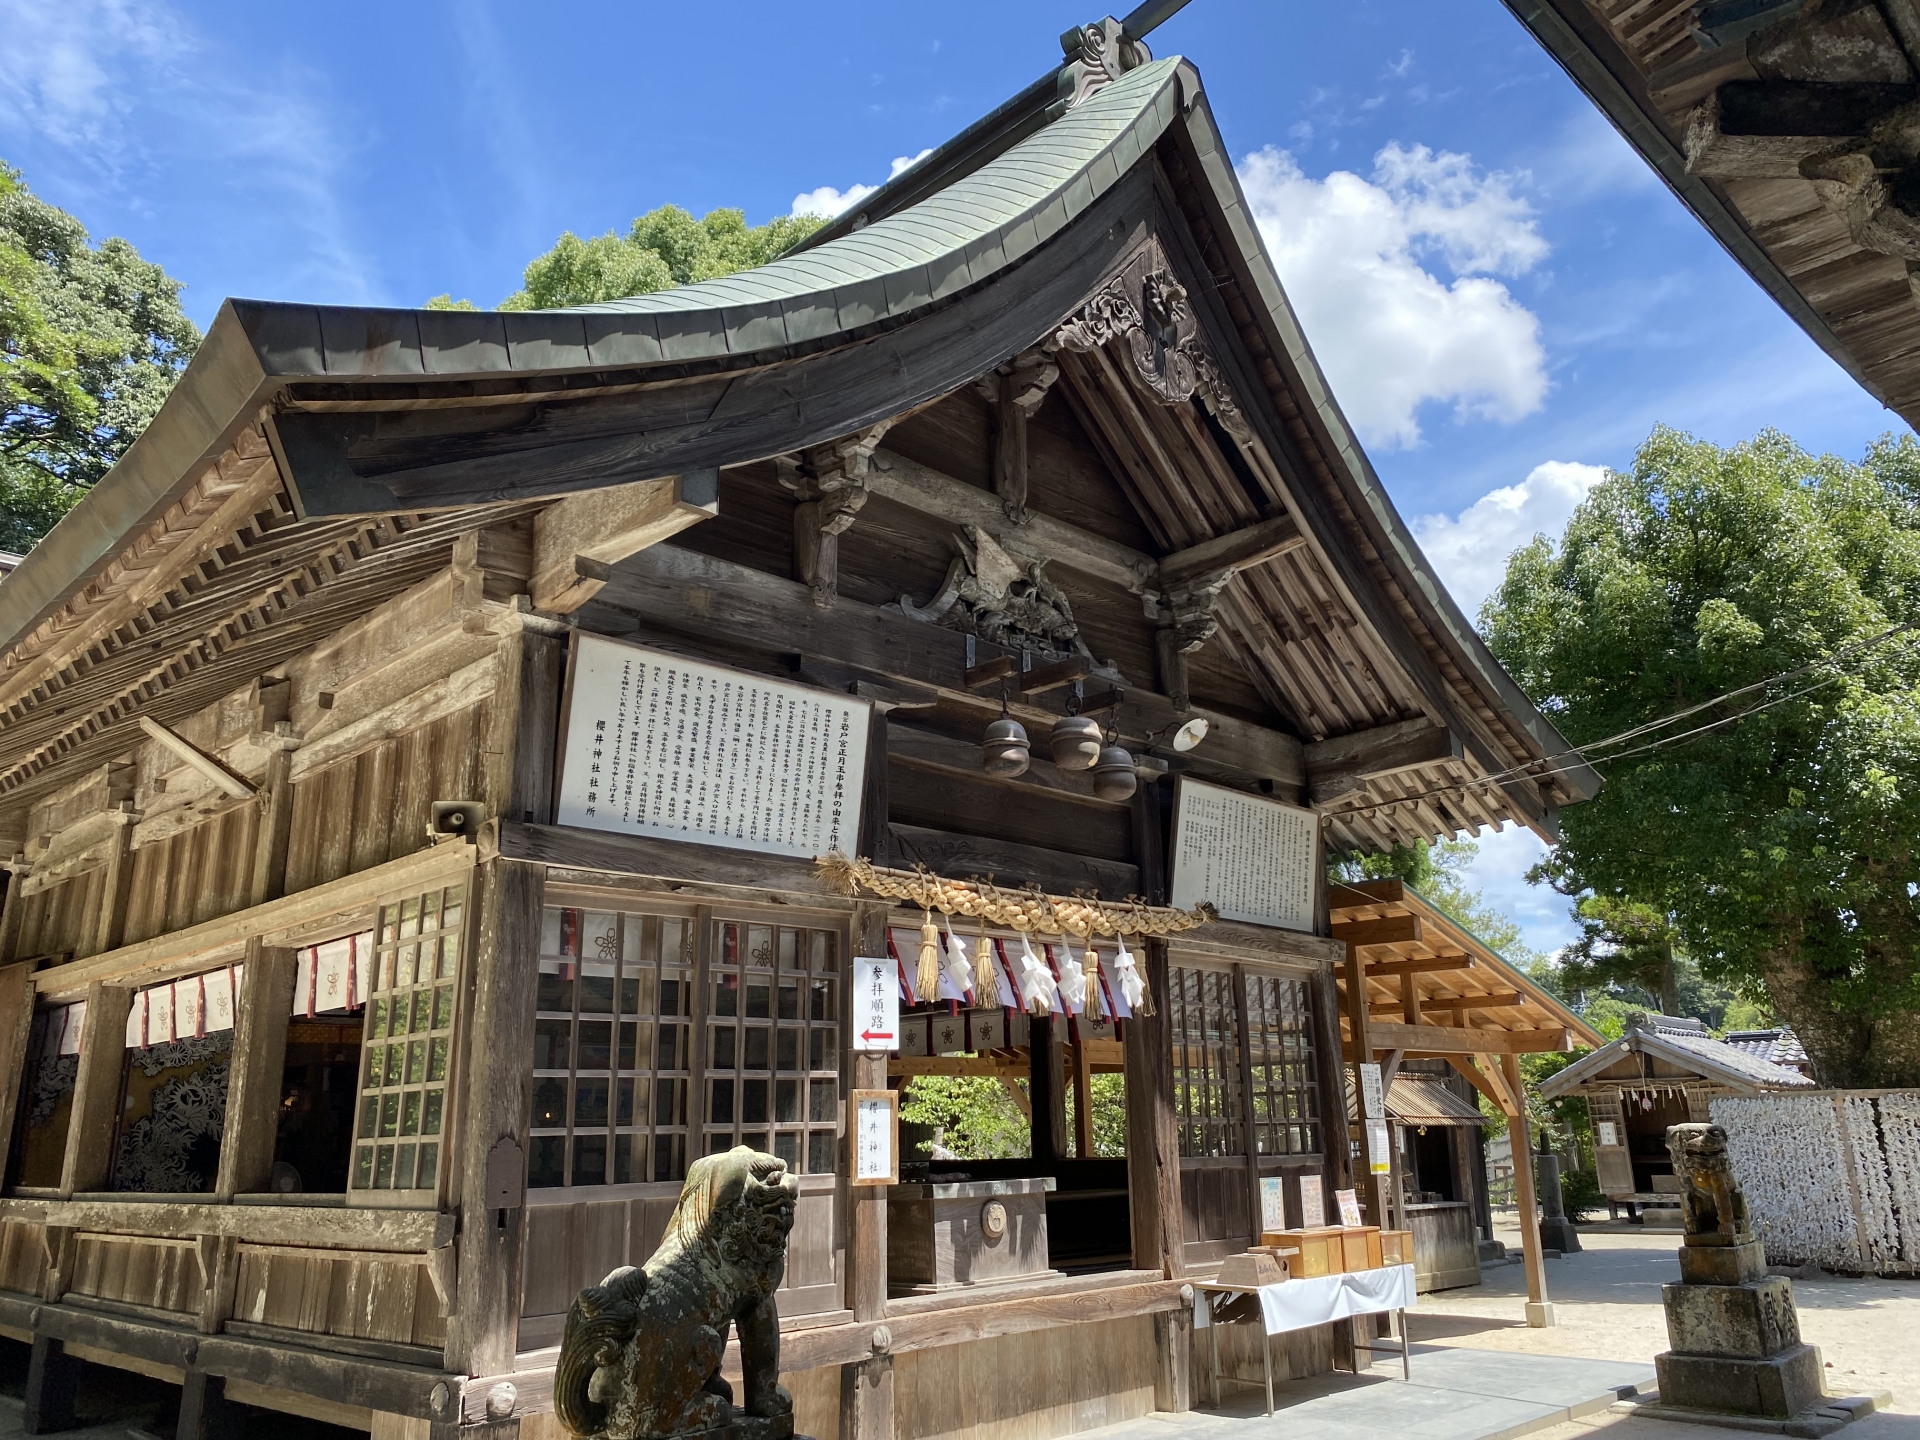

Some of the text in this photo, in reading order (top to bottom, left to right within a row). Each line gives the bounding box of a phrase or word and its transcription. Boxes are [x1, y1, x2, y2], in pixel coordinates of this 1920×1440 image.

[585, 719, 605, 817] 櫻井神社社務所
[871, 965, 885, 1029] 参拝順路
[869, 1101, 879, 1174] 櫻井神社
